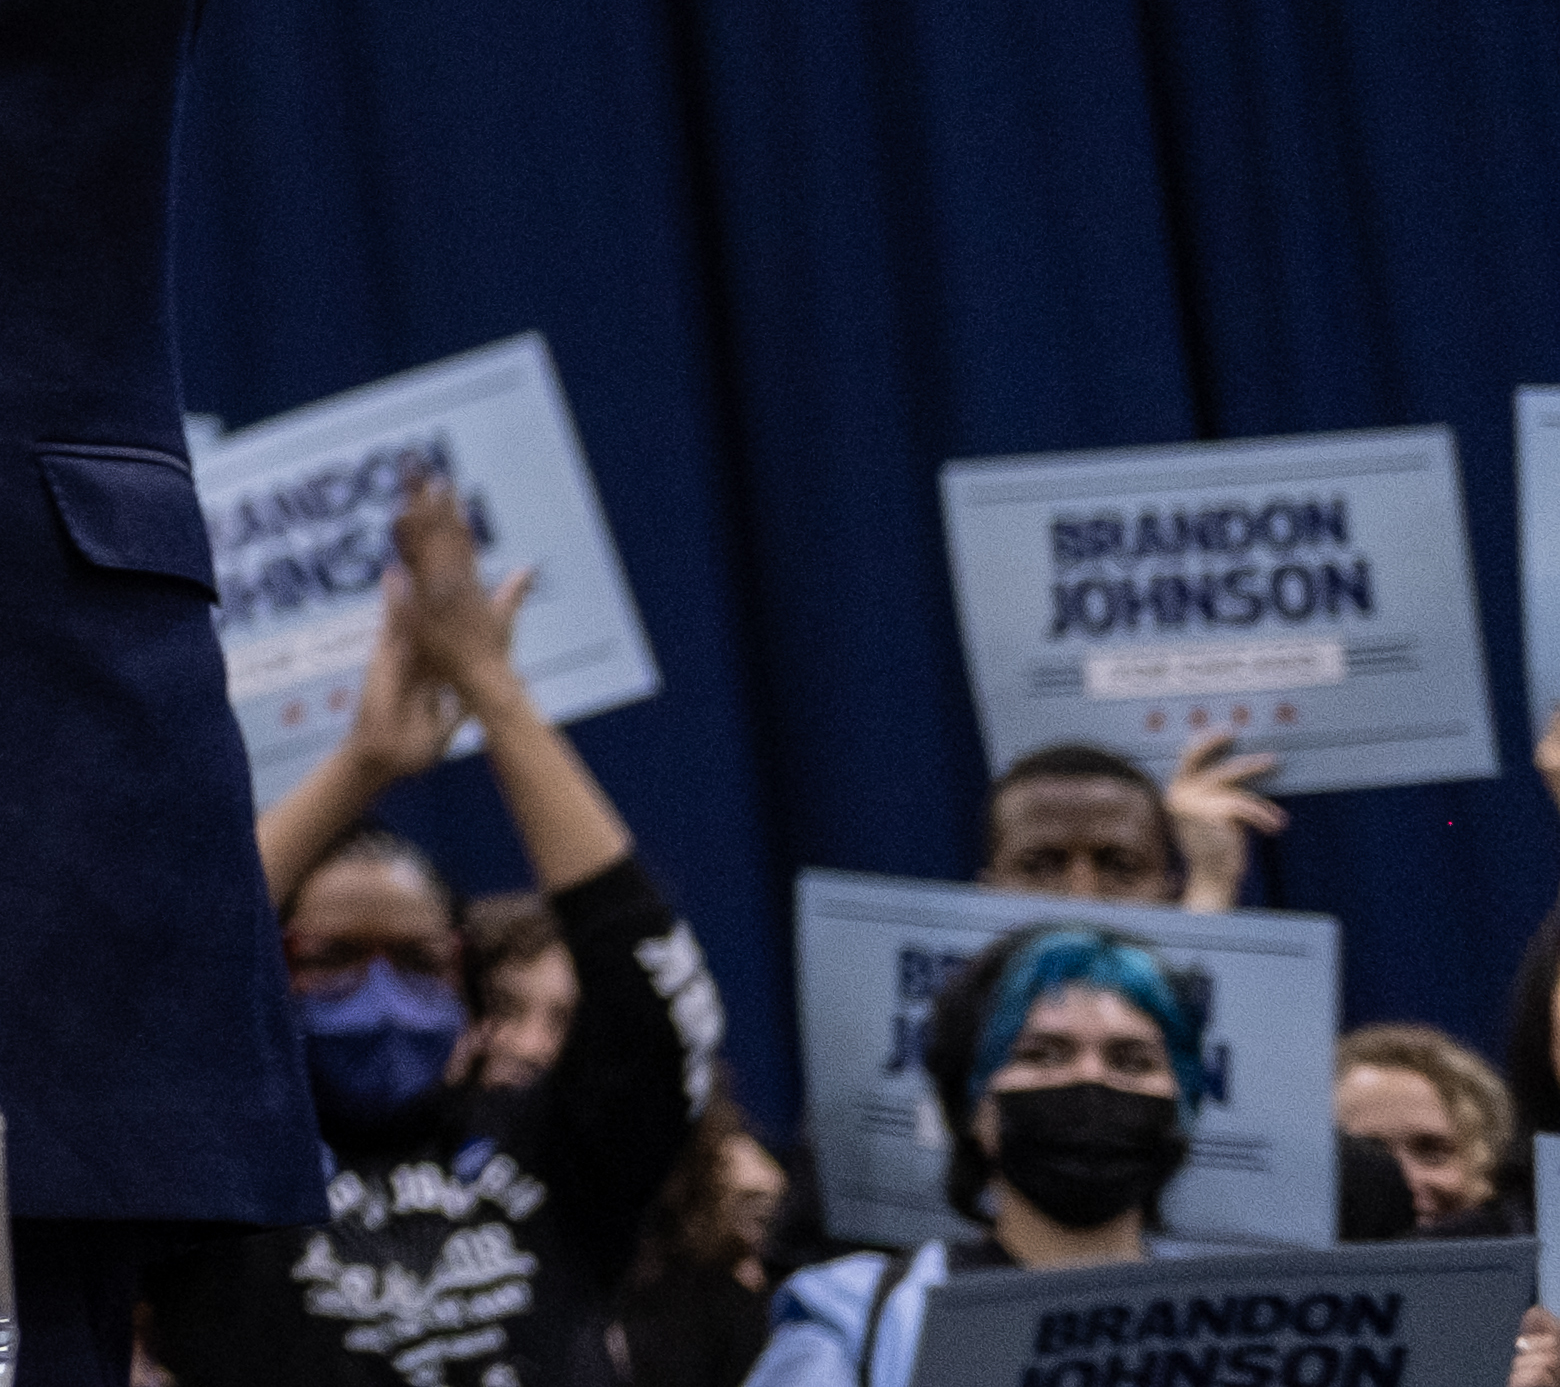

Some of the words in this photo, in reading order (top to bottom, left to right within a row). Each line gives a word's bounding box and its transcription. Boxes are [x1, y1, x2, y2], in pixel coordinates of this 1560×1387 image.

[1050, 497, 1348, 567] BRANDON
[1045, 555, 1376, 640] JOHNSON
[1035, 1292, 1403, 1357] BRANDON
